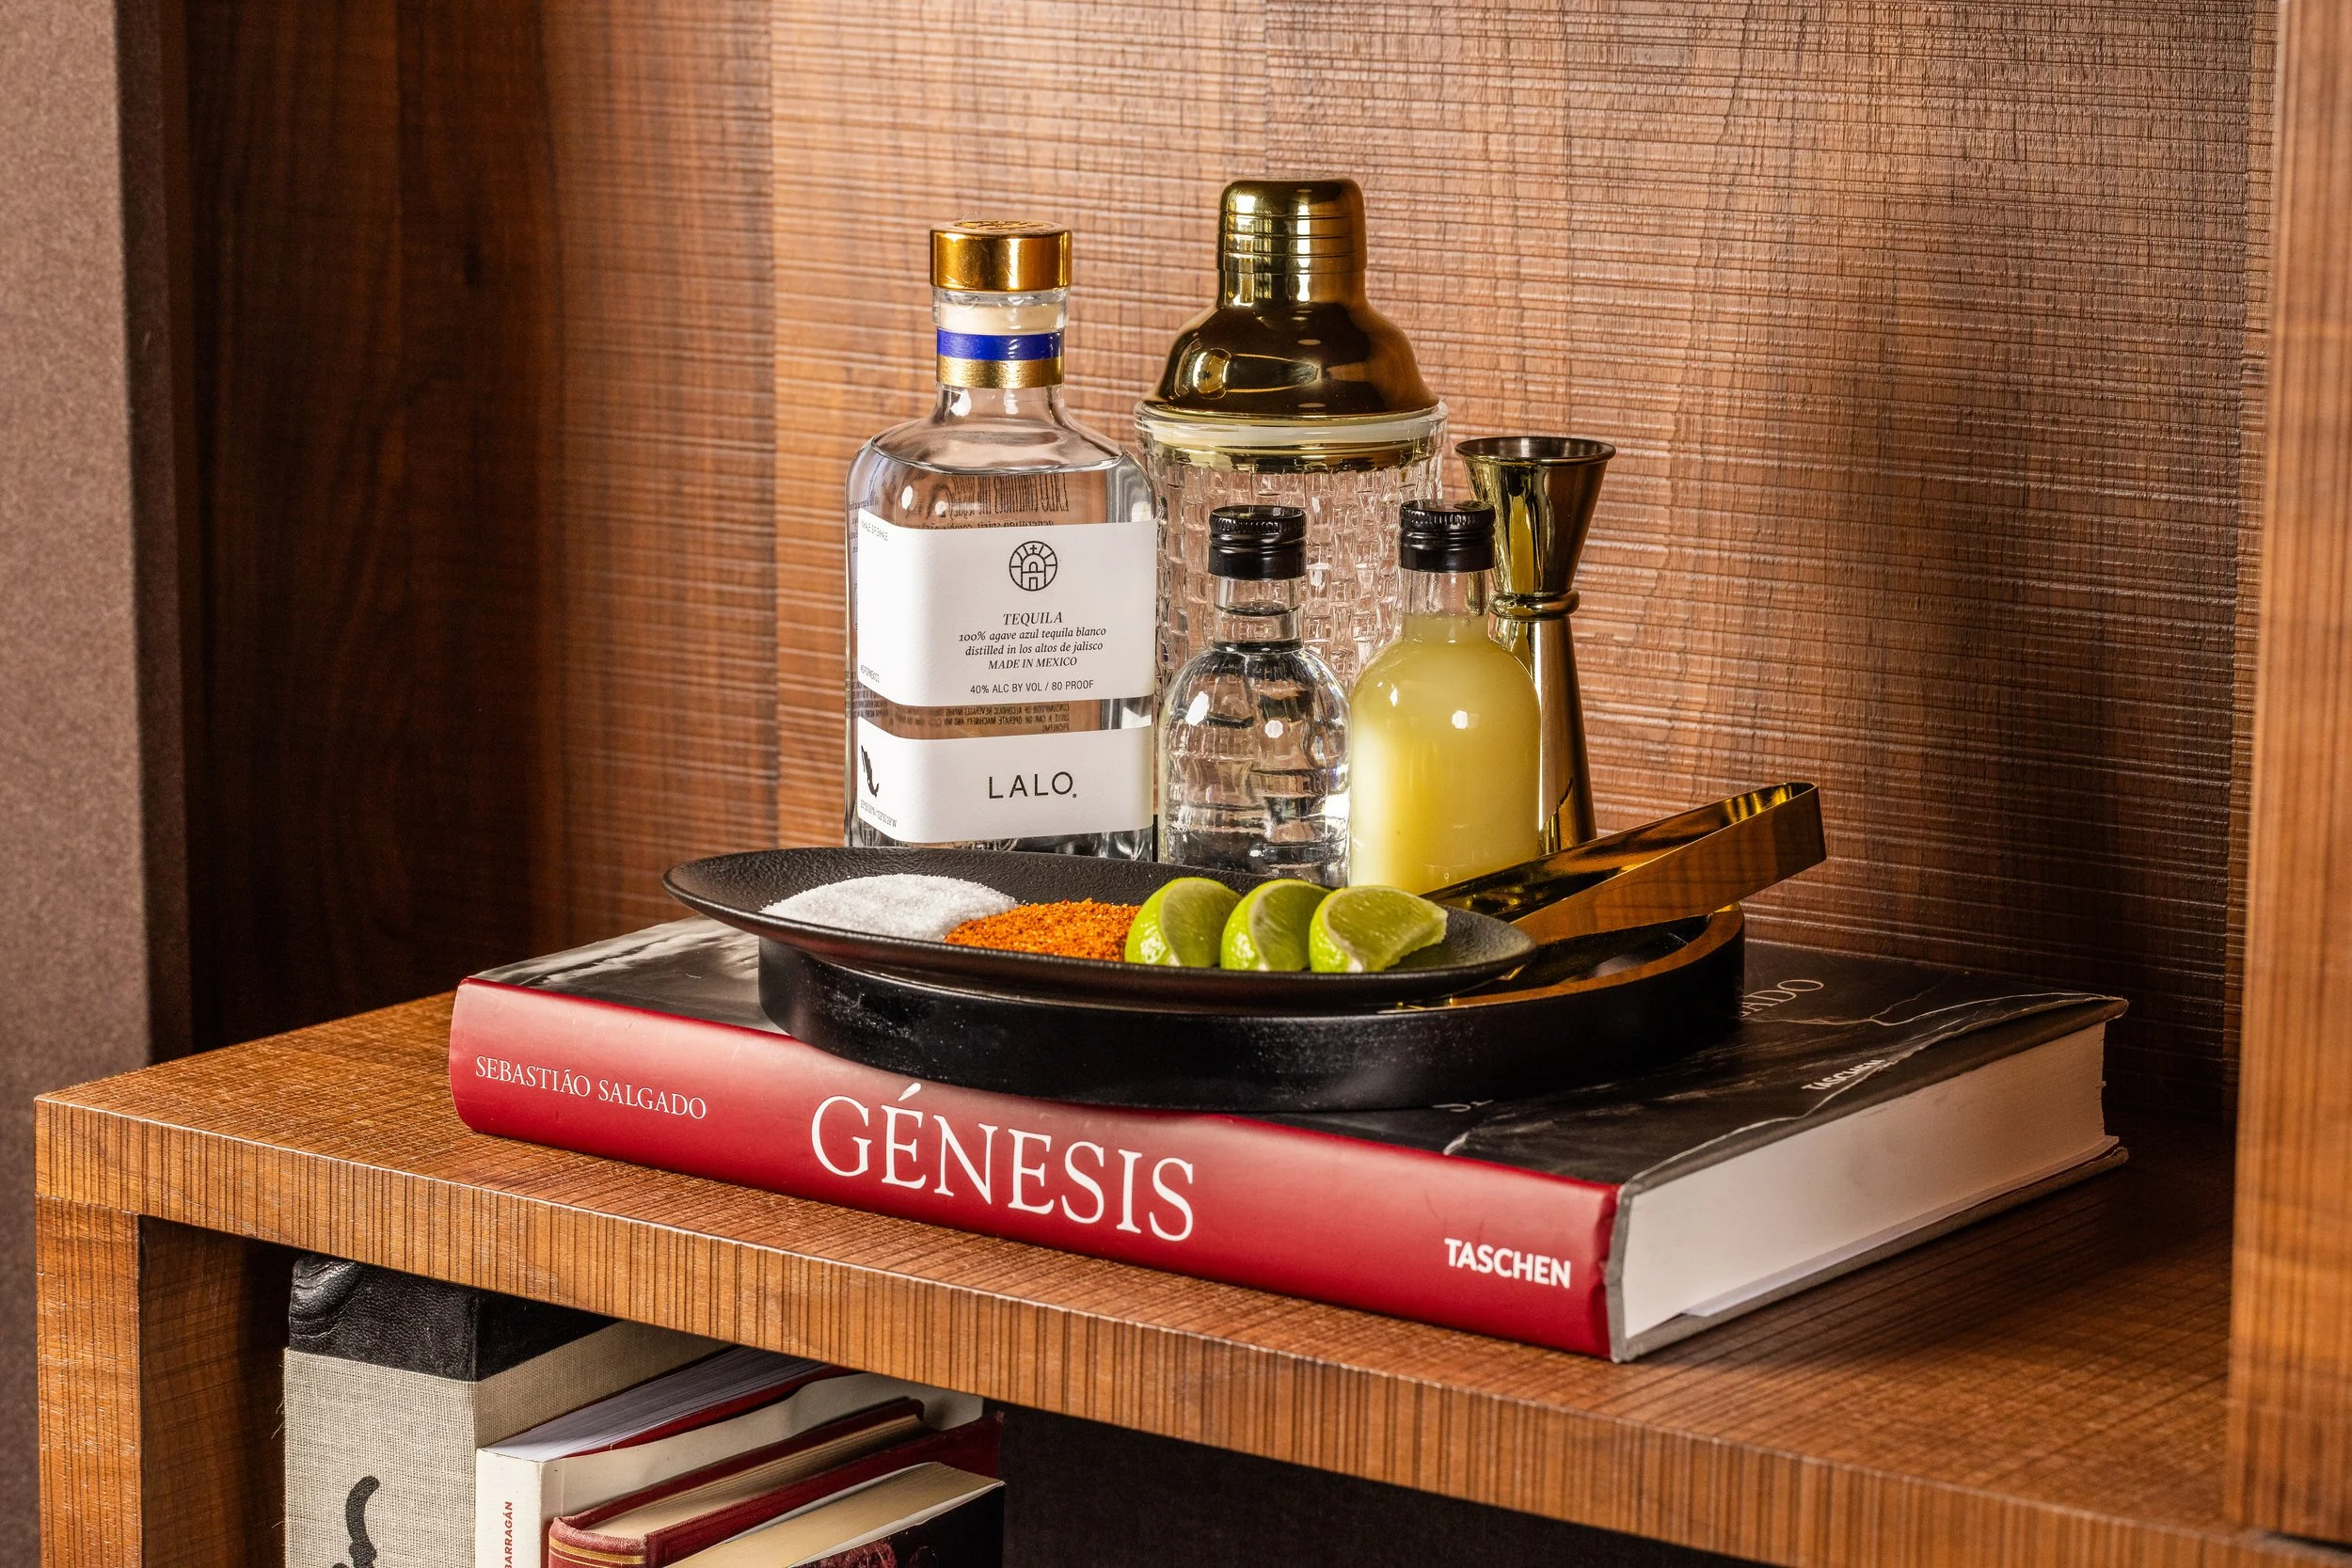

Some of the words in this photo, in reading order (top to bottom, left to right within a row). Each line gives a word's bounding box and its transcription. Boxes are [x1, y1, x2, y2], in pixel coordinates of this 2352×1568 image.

[1003, 611, 1063, 626] TEQUILA
[958, 630, 986, 641] 100%
[989, 631, 1017, 642] agave
[1019, 628, 1039, 640] azul
[1041, 627, 1073, 641] tequila
[1075, 626, 1106, 638] blanco
[965, 645, 1004, 657] distilled
[1007, 644, 1016, 655] in
[1019, 643, 1032, 655] los
[1035, 641, 1057, 654] altos
[1059, 641, 1071, 653] de
[1072, 641, 1104, 654] jalisco
[988, 658, 1021, 671] MADE
[1022, 658, 1035, 669] IN
[1035, 657, 1077, 668] MEXICO
[970, 684, 990, 694] 40%
[992, 683, 1009, 693] ALC
[1011, 682, 1024, 692] BY
[1025, 681, 1042, 692] VOL
[1044, 681, 1049, 691] /
[1051, 680, 1063, 691] 80
[1065, 679, 1094, 690] PROOF
[475, 1055, 591, 1098] SEBASTIÃO
[597, 1079, 707, 1120] SALGADO
[811, 1082, 1194, 1242] GÉNESIS
[1444, 1238, 1571, 1289] TASCHEN
